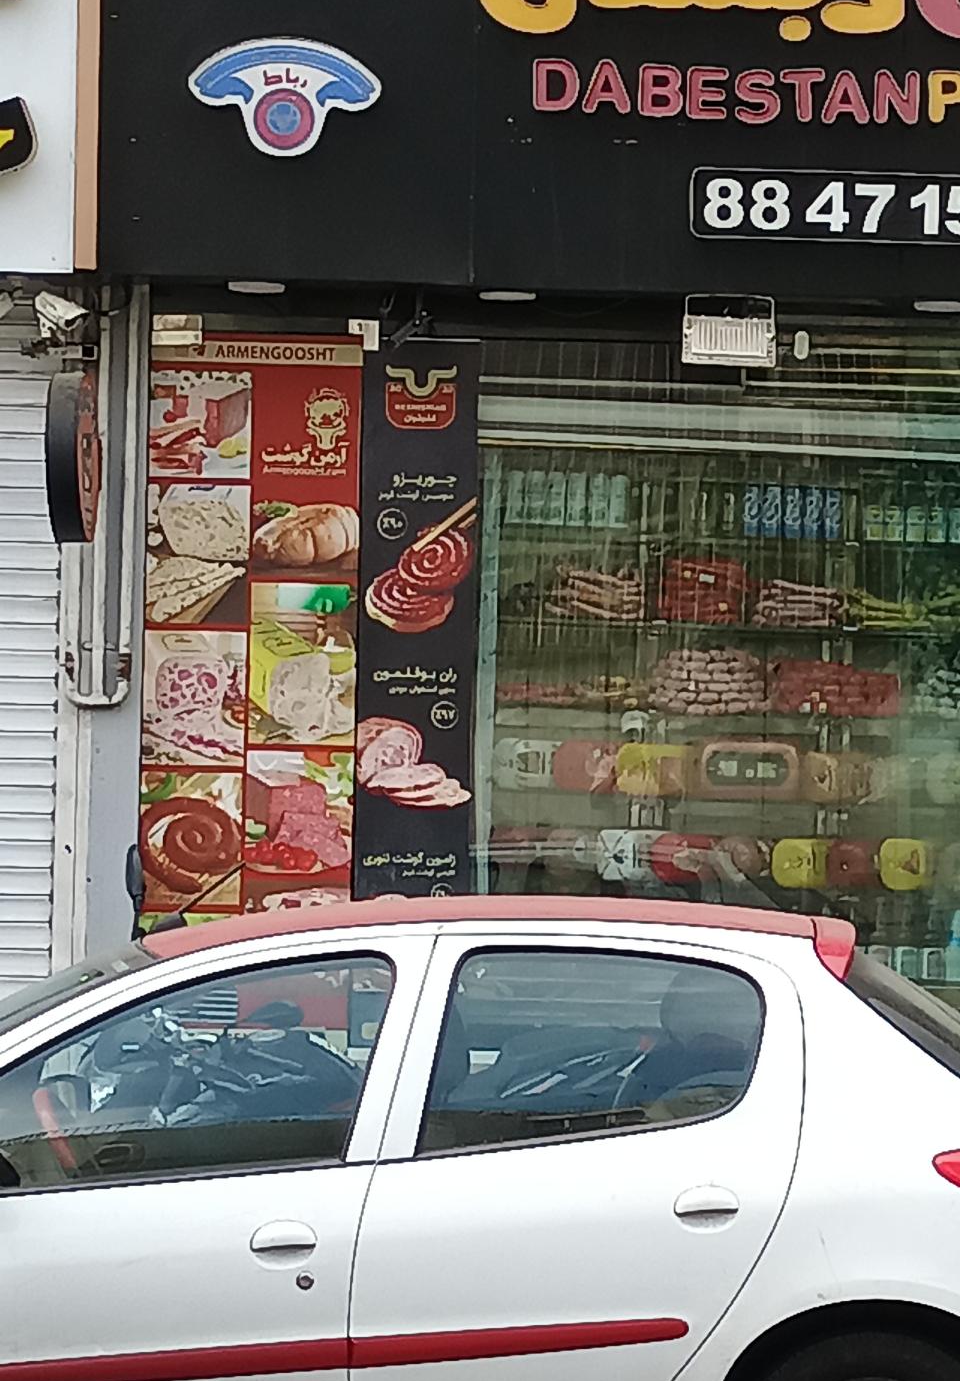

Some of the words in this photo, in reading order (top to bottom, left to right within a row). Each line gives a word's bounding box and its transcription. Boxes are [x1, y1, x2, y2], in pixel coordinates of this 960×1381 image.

[263, 67, 308, 88] رباط
[215, 345, 336, 362] ARMENGOOSHT
[261, 442, 312, 466] گوشت
[310, 441, 350, 467] آرمن
